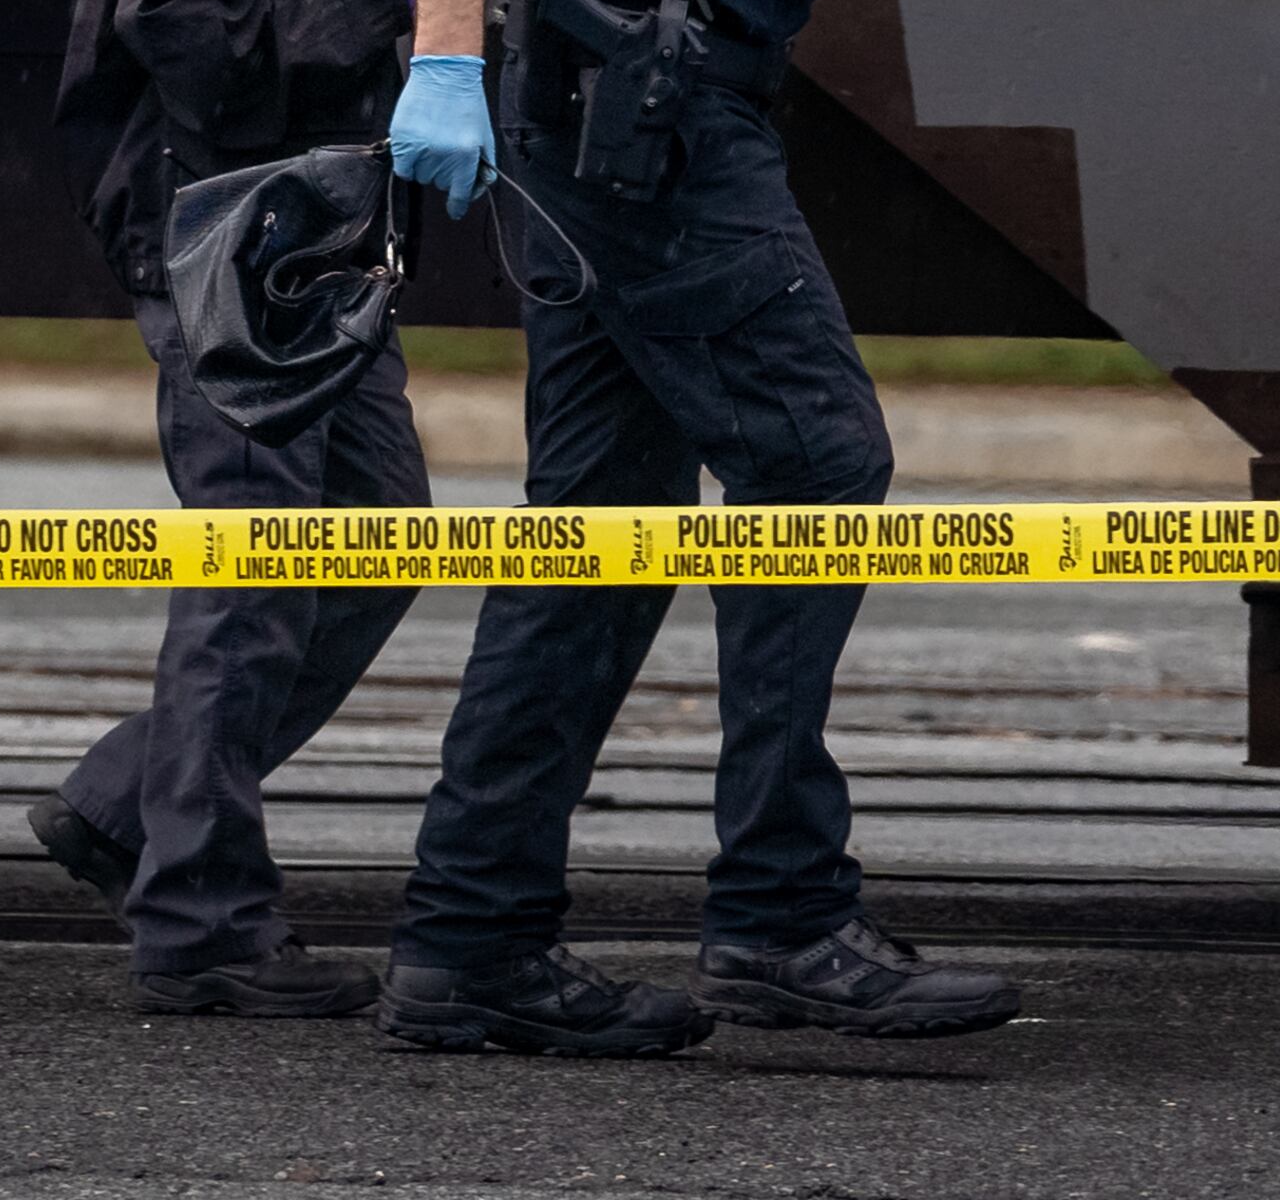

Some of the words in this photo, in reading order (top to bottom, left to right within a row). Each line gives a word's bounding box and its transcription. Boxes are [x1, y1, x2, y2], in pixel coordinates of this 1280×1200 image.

[20, 518, 68, 553] NOT
[75, 518, 157, 553] CROSS
[249, 516, 335, 551] POLICE
[343, 516, 398, 551] LINE
[406, 515, 439, 551] DO
[448, 515, 496, 551] NOT
[504, 515, 586, 550] CROSS
[678, 514, 764, 549] POLICE
[772, 513, 826, 548] LINE
[834, 513, 869, 548] DO
[877, 513, 924, 548] NOT
[932, 512, 1014, 548] CROSS
[1106, 510, 1193, 545] POLICE
[1201, 509, 1255, 544] LINE
[10, 558, 67, 581] FAVOR
[72, 557, 97, 581] NO
[102, 557, 173, 581] CRUZAR
[235, 556, 288, 580] LINEA
[293, 556, 317, 580] DE
[322, 555, 391, 580] POLICIA
[396, 555, 432, 579] POR
[438, 555, 494, 579] FAVOR
[500, 555, 525, 579] NO
[530, 554, 601, 579] CRUZAR
[663, 553, 716, 578] LINEA
[721, 553, 745, 577] DE
[750, 553, 820, 577] POLICIA
[824, 553, 861, 577] POR
[866, 553, 923, 576] FAVOR
[928, 552, 953, 576] NO
[959, 551, 1030, 576] CRUZAR
[1092, 550, 1145, 575] LINEA
[1150, 549, 1174, 575] DE
[1179, 549, 1249, 574] POLICIA
